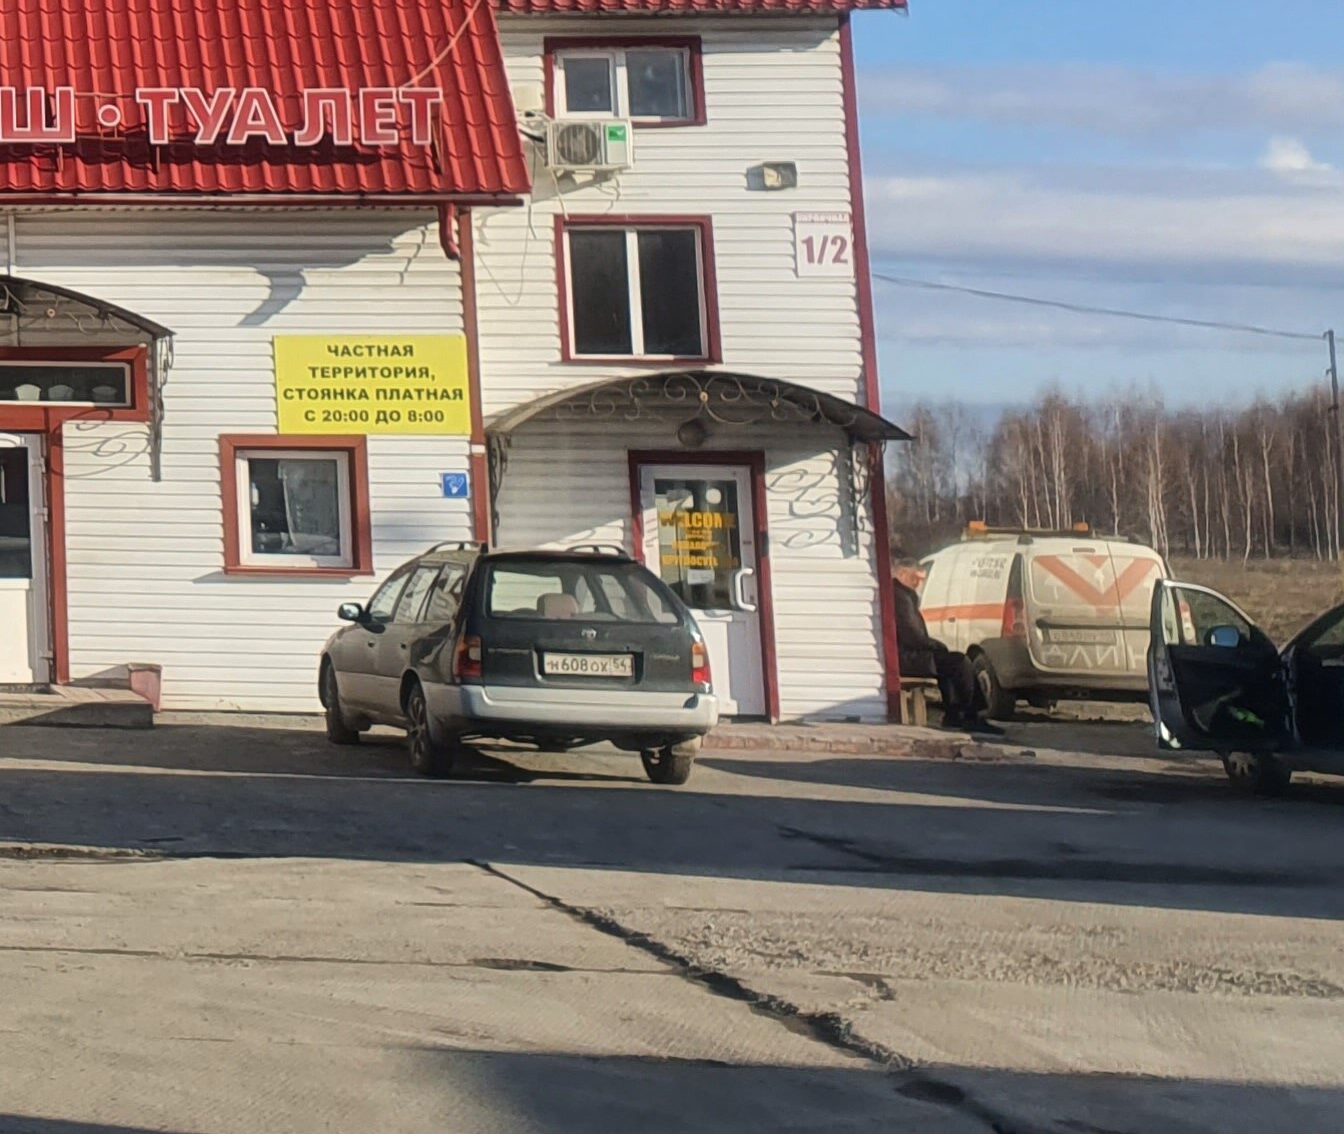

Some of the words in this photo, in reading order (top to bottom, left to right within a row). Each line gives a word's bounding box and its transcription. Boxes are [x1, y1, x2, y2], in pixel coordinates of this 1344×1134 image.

[135, 85, 443, 148] ТУАЛЕТ
[801, 234, 849, 265] 1/2
[327, 344, 414, 357] ЧАСТНАЯ
[308, 366, 436, 382] ТЕРРИТОРИЯ,
[283, 388, 370, 401] СТОЯНКА
[375, 388, 464, 401] ПЛАТНАЯ
[304, 409, 316, 422] С
[322, 409, 369, 422] 20:00
[375, 409, 401, 425] ДО
[408, 409, 445, 422] 8:00
